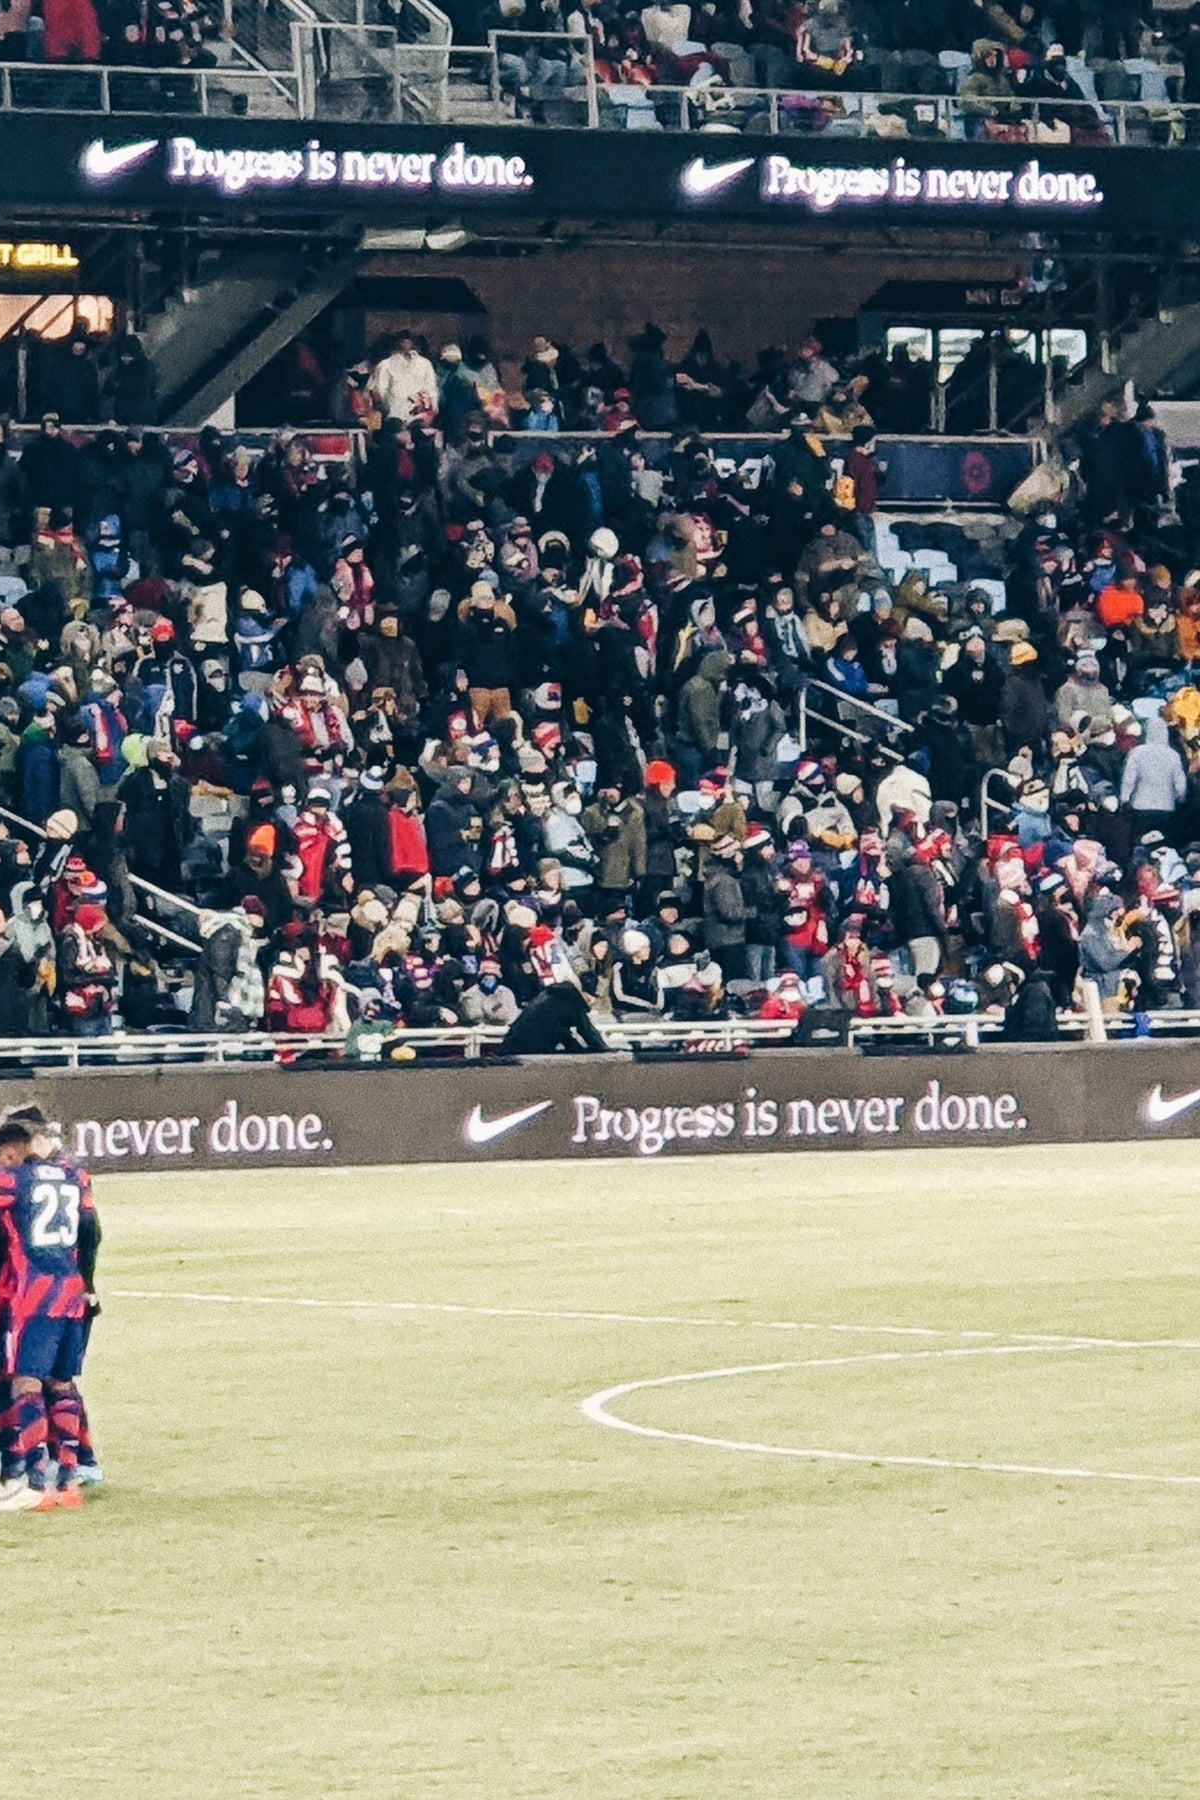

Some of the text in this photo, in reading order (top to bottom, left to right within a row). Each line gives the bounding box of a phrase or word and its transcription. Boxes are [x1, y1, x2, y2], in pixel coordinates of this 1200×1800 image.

[170, 136, 535, 191] Progress is never done.
[766, 155, 1104, 207] Progress is never done.
[14, 243, 80, 267] GRILL
[74, 1115, 200, 1158] never
[210, 1100, 334, 1152] done.
[571, 1079, 1028, 1155] Progress is never done.
[31, 1183, 81, 1248] 23
